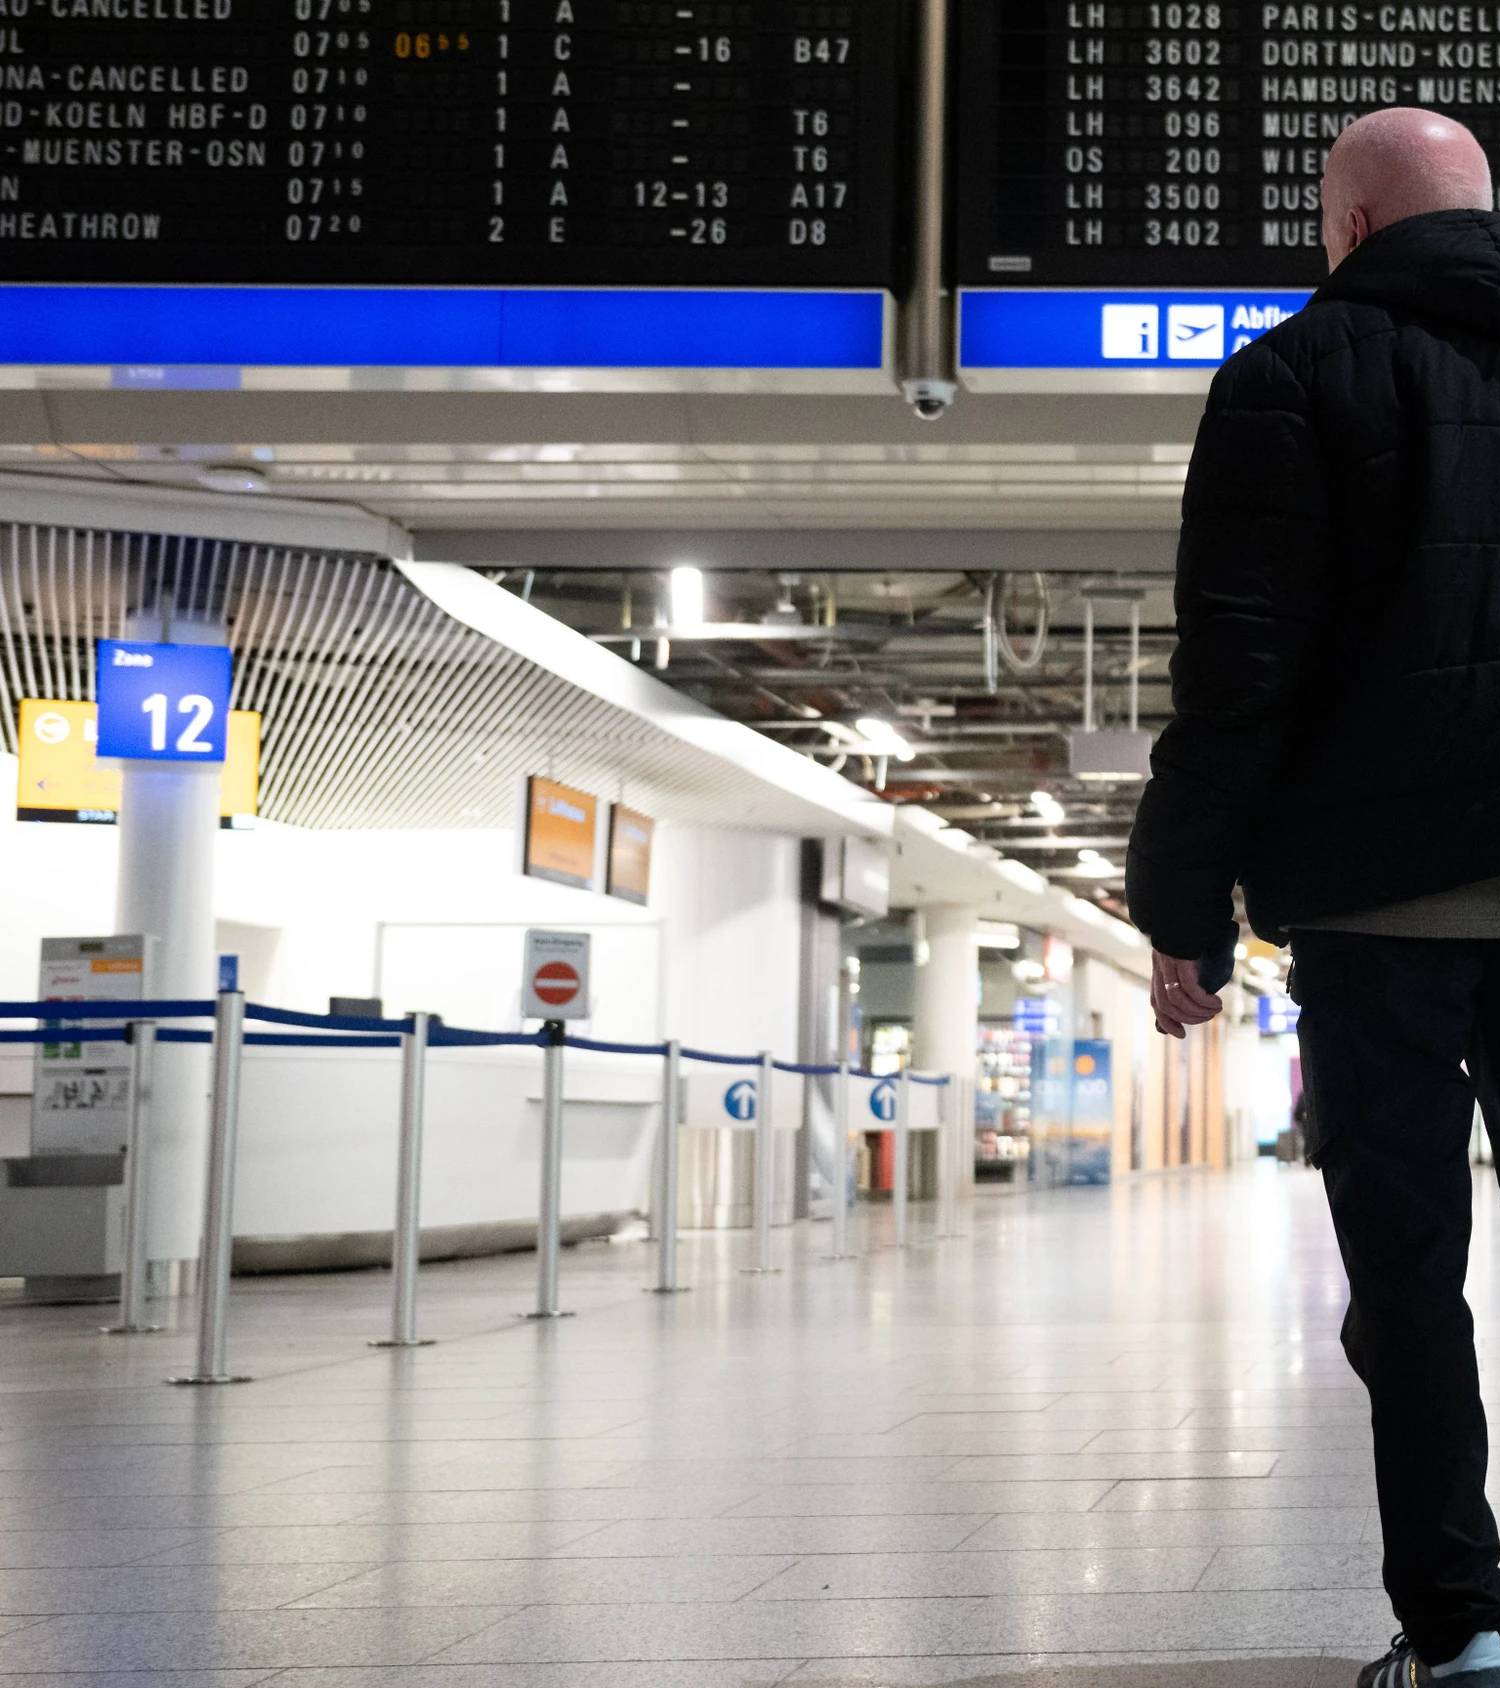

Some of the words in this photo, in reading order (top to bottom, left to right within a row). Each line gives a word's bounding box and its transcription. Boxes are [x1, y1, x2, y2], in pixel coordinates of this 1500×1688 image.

[500, 0, 510, 22] 1
[556, 0, 574, 23] A
[1068, 3, 1105, 28] LH
[1150, 3, 1221, 30] 1028
[293, 31, 370, 58] 0705
[394, 32, 470, 59] 0655
[498, 34, 509, 59] 1
[554, 34, 571, 61] C
[794, 37, 850, 64] B47
[1067, 39, 1104, 64] LH
[1146, 38, 1221, 66] 3602
[0, 64, 249, 93] NA-CANCELLED
[292, 67, 368, 94] 0710
[497, 70, 507, 95] 1
[552, 71, 571, 96] A
[1067, 75, 1104, 101] LH
[1146, 75, 1220, 102] 3642
[168, 103, 267, 130] HBF-D
[290, 104, 367, 131] 0710
[496, 107, 507, 132] 1
[552, 107, 570, 132] A
[794, 109, 828, 137] T6
[1067, 111, 1104, 137] LH
[1165, 111, 1220, 138] 096
[288, 140, 364, 168] 0710
[494, 143, 504, 169] 1
[550, 143, 569, 169] A
[793, 145, 828, 173] T6
[1066, 146, 1103, 173] OS
[1166, 147, 1221, 174] 200
[287, 177, 363, 205] 0715
[493, 180, 503, 205] 1
[549, 180, 568, 206] A
[635, 181, 728, 208] 12-13
[790, 182, 847, 209] A17
[1066, 183, 1103, 209] LH
[1145, 183, 1220, 210] 3500
[1262, 184, 1321, 211] DUS
[0, 212, 161, 240] HEATHROW
[285, 214, 361, 241] 0720
[488, 216, 504, 243] 2
[549, 217, 564, 243] E
[789, 218, 826, 246] D8
[1066, 220, 1103, 246] LH
[1145, 219, 1220, 246] 3402
[1262, 221, 1327, 247] MUE
[142, 693, 214, 752] 12
